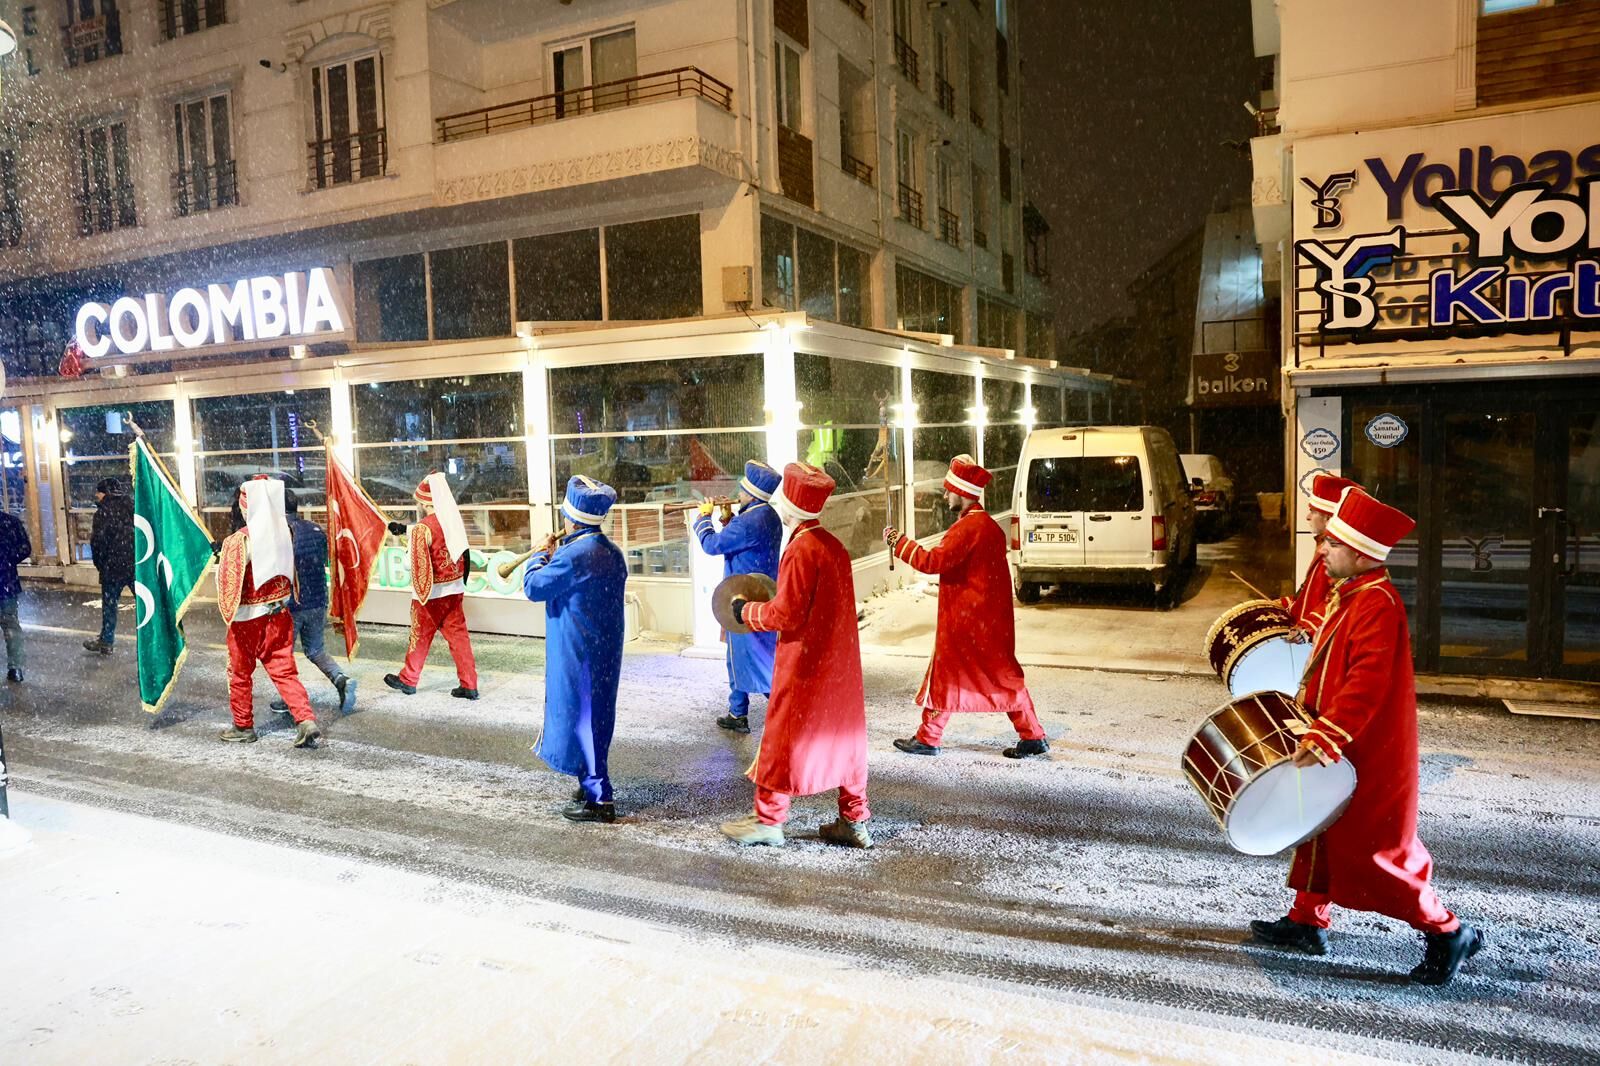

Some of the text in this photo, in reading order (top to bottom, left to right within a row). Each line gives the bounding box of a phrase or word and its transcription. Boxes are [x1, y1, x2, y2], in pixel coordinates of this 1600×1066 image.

[75, 267, 345, 358] COLOMBIA
[1223, 353, 1240, 372] 3
[1197, 375, 1268, 395] balkon
[1033, 533, 1075, 542] 34 TP 5104
